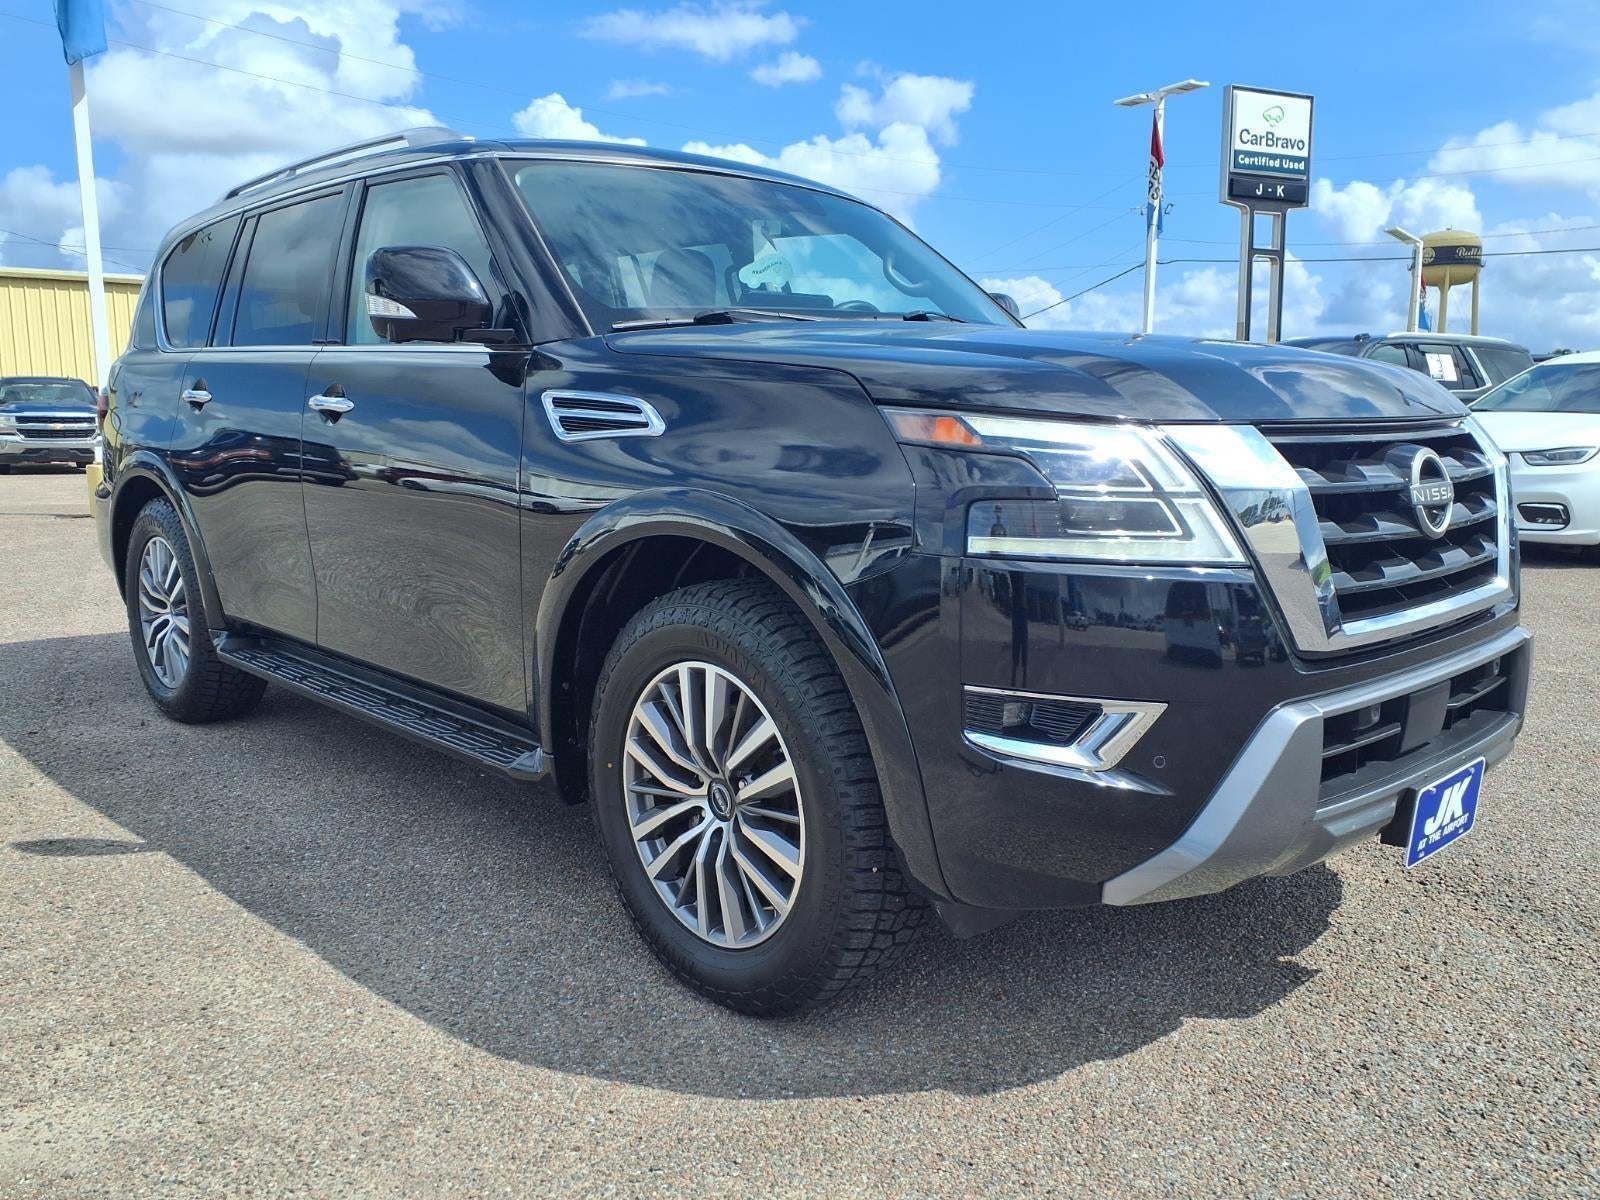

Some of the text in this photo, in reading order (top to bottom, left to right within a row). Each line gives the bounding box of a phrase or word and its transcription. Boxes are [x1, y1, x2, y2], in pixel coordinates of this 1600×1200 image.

[1239, 128, 1305, 151] CarBravo
[1238, 154, 1305, 170] Certified Used
[1255, 183, 1263, 195] J
[1276, 185, 1285, 197] K
[1413, 486, 1453, 502] NISSA
[1424, 775, 1473, 836] JK
[1417, 813, 1469, 851] AT THE AIRPORT
